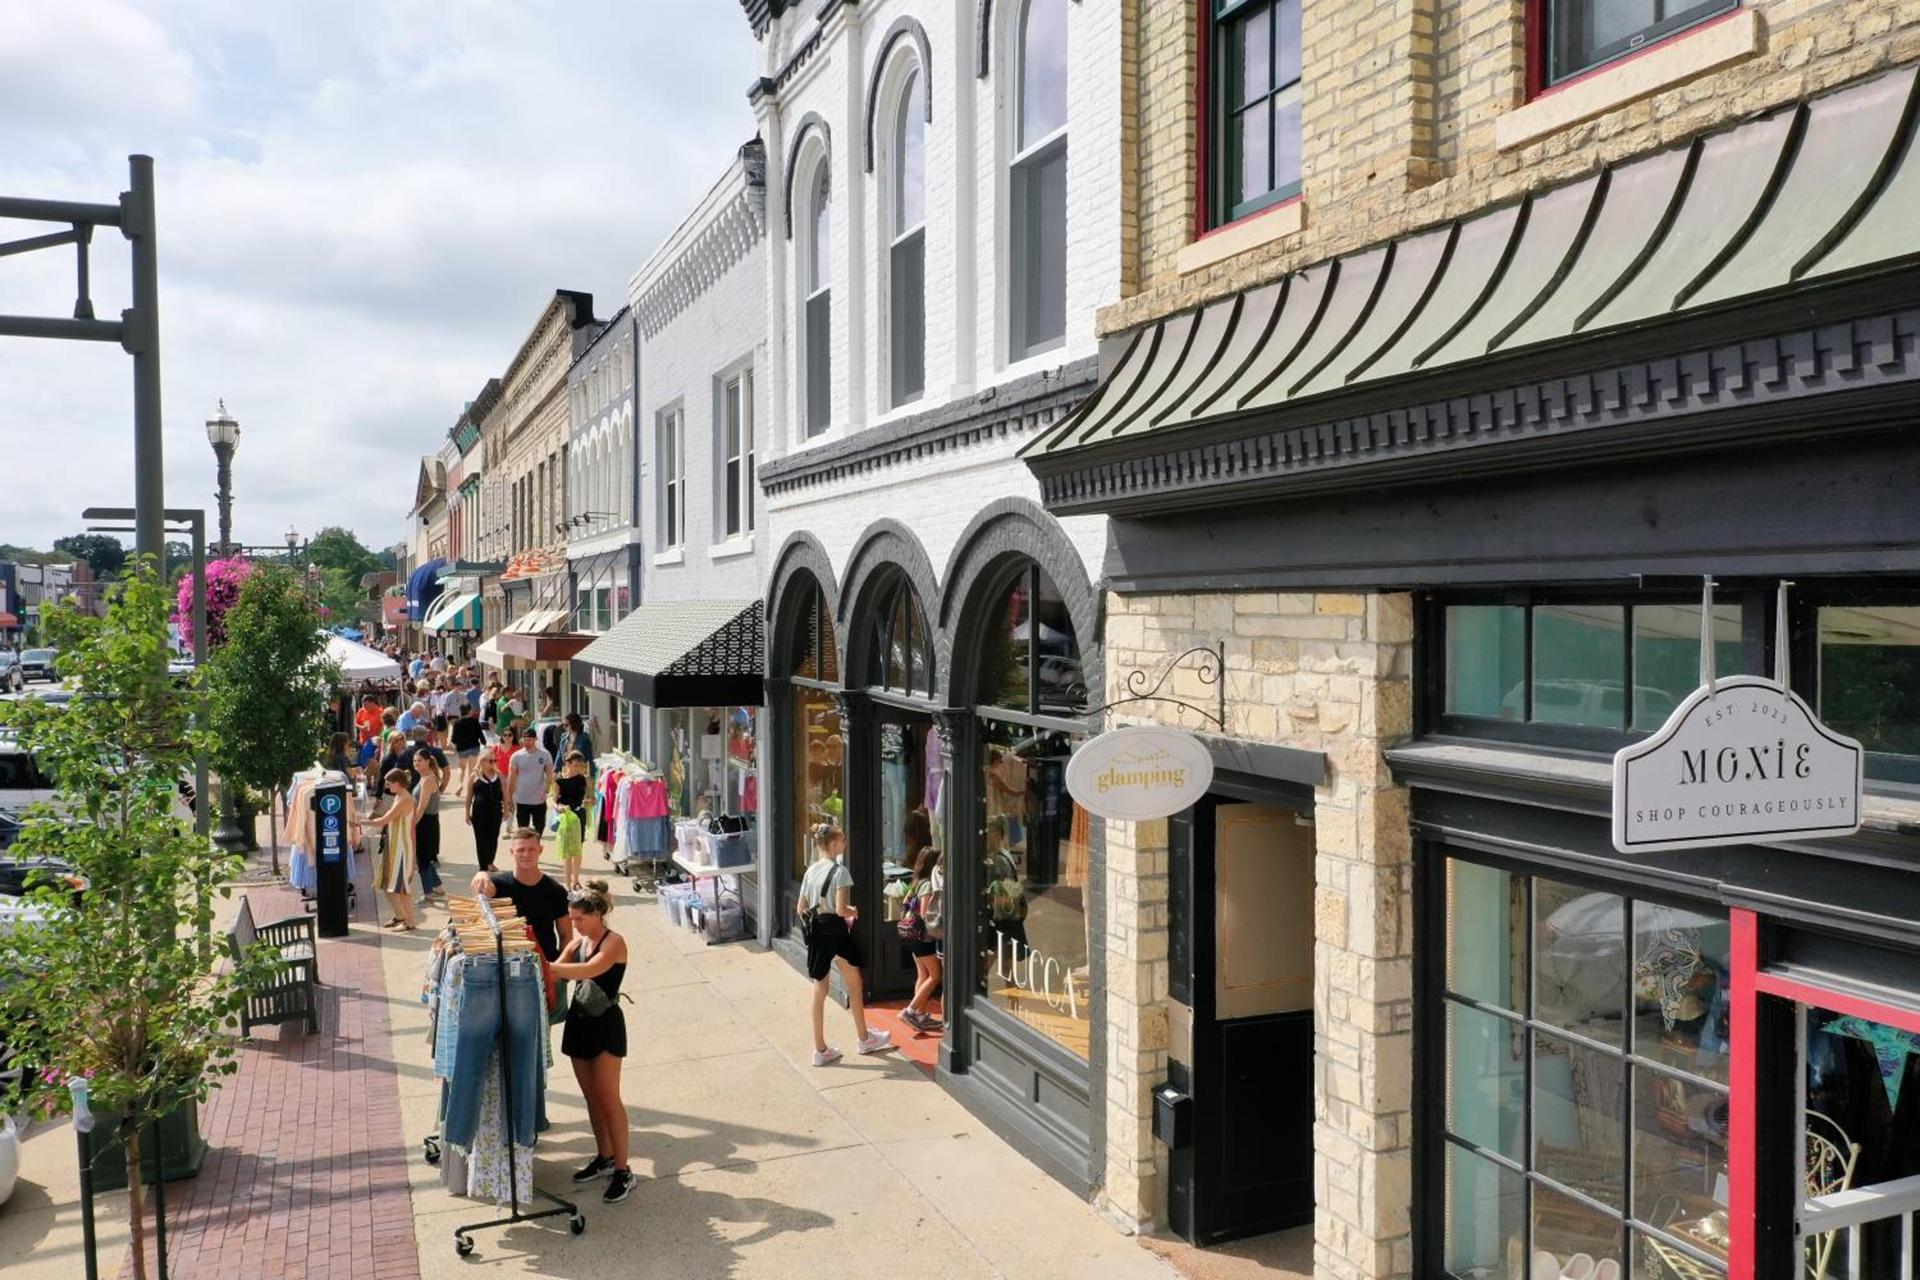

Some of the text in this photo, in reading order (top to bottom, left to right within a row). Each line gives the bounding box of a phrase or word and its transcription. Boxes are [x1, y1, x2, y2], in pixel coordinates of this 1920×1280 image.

[1704, 704, 1741, 727] EST.
[1097, 766, 1186, 793] glamping
[1636, 797, 1849, 823] SHOP COURAGEOUSLY
[996, 929, 1078, 1020] LUCCA
